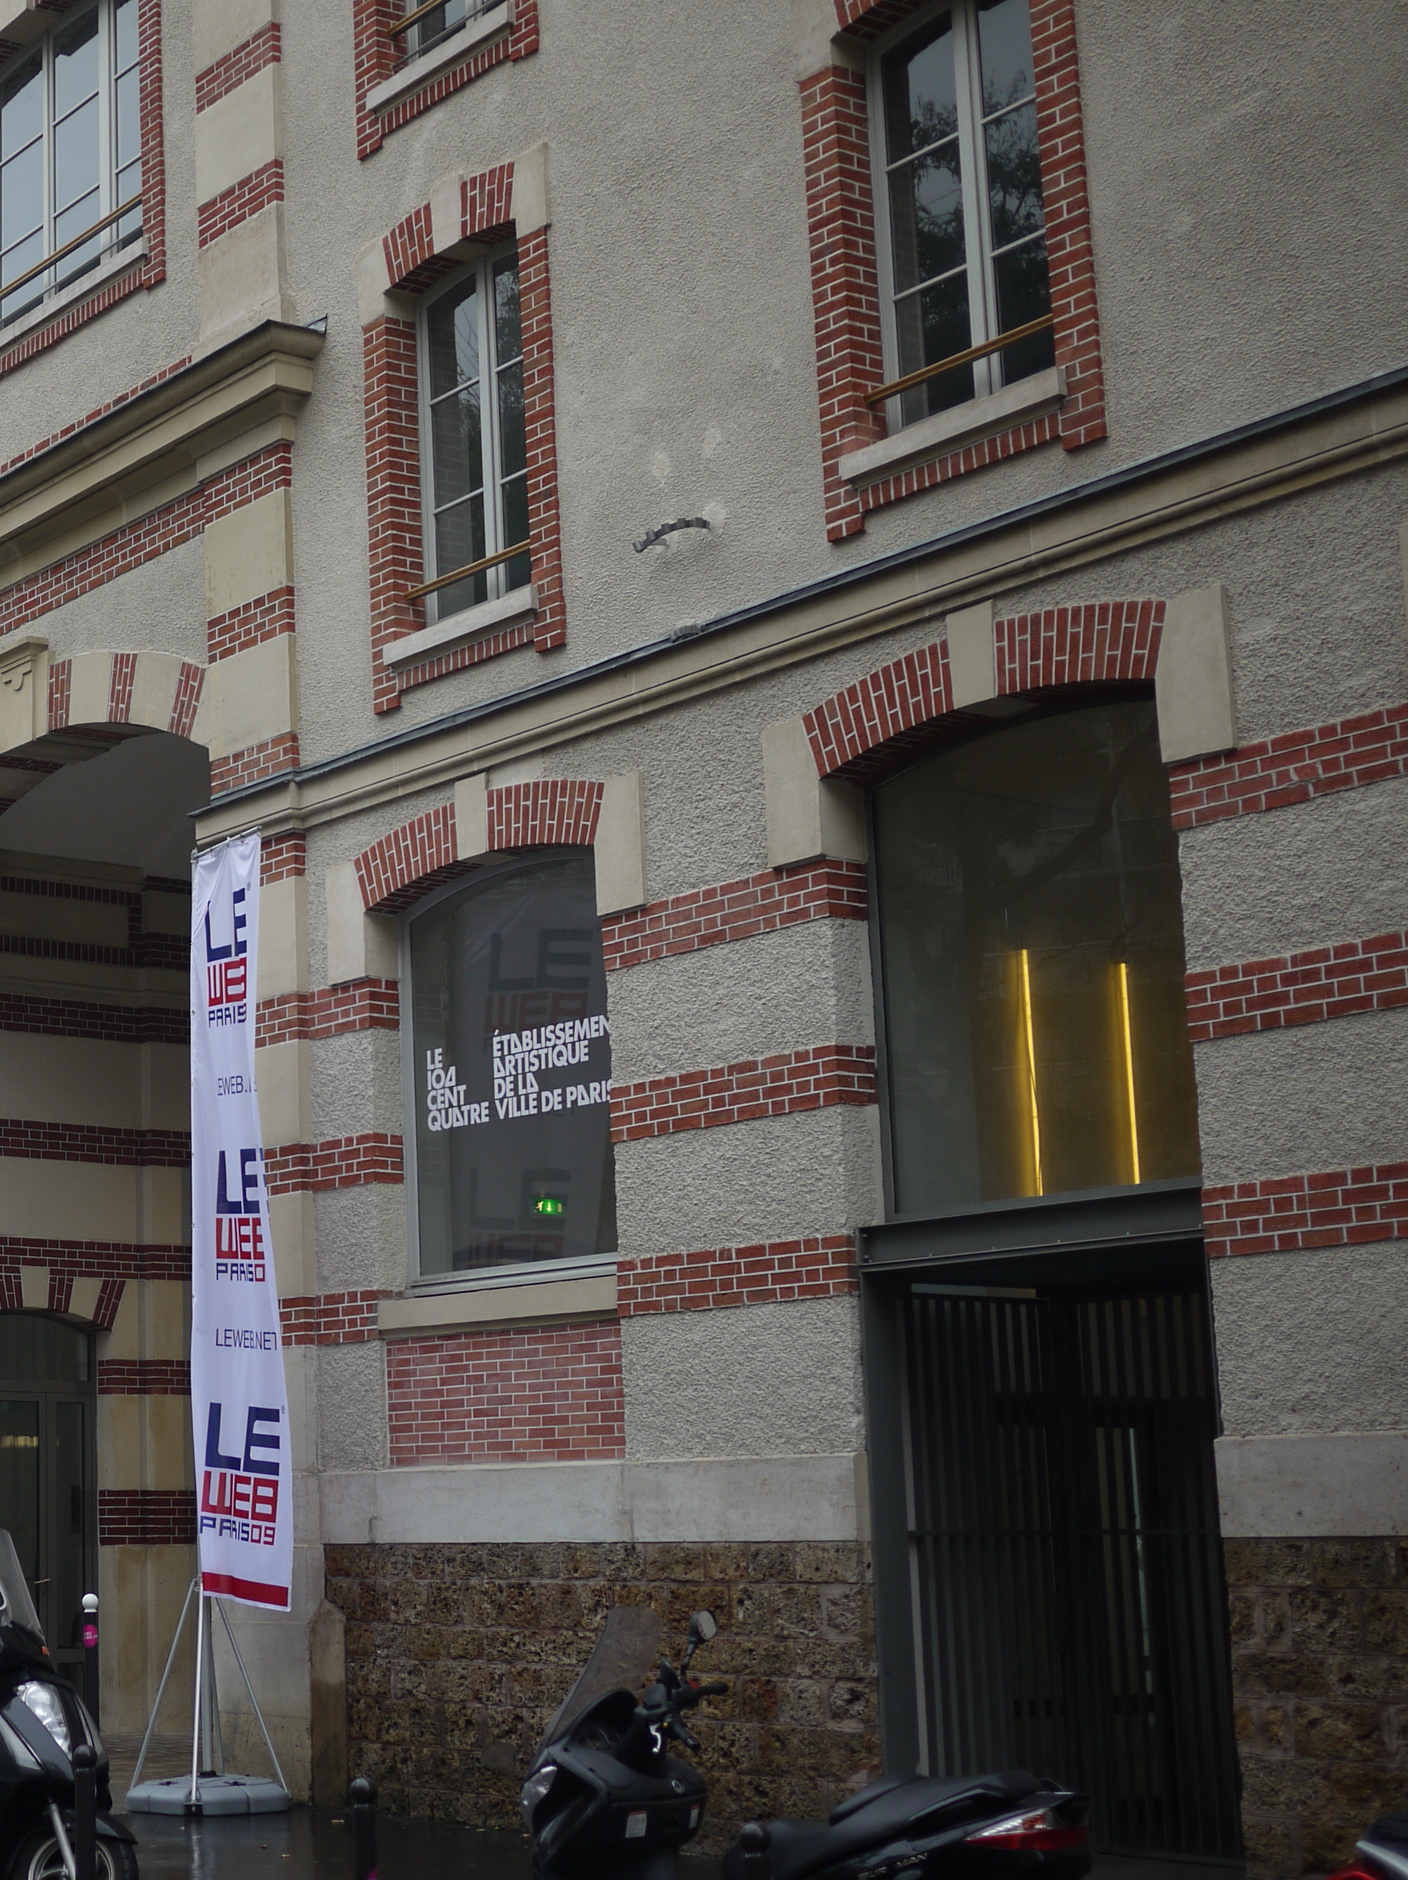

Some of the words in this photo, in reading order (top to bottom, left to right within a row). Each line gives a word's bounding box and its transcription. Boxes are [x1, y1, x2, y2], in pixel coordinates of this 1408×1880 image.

[204, 887, 247, 963] LE
[492, 1014, 610, 1057] ÉTABLISSEMEN
[426, 1048, 443, 1070] LE
[493, 1040, 590, 1079] ARTISTIQUE
[427, 1085, 467, 1111] CENT
[493, 1077, 516, 1100] DE
[518, 1072, 539, 1096] LA
[494, 1093, 538, 1120] VILLE
[541, 1089, 563, 1113] DE
[566, 1079, 612, 1108] PARIS
[427, 1100, 490, 1132] QUATRE
[216, 1148, 260, 1214] LE
[205, 1402, 280, 1476] LE
[201, 1470, 279, 1523] WEB
[199, 1515, 275, 1546] PARIS09
